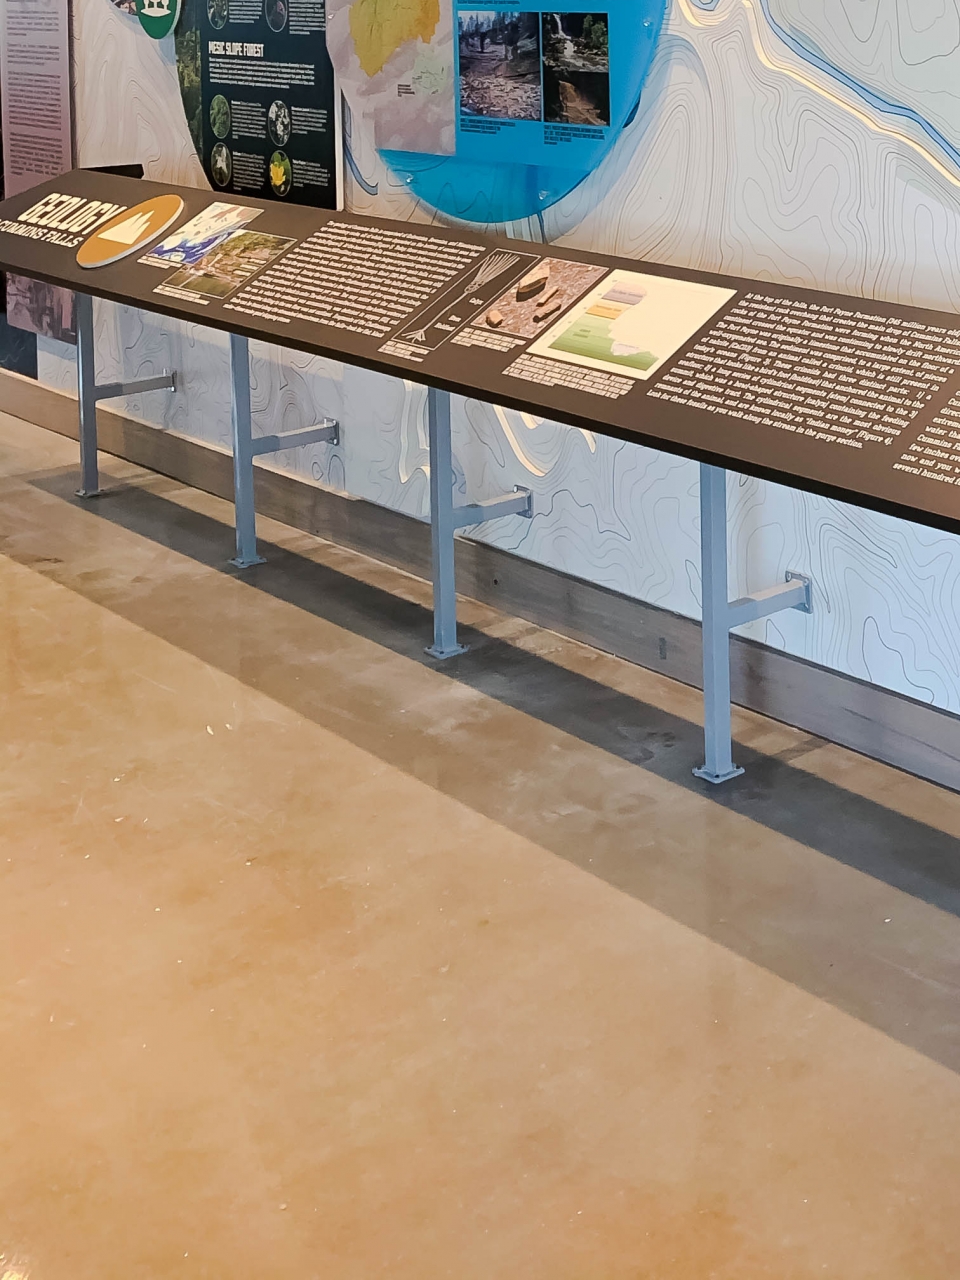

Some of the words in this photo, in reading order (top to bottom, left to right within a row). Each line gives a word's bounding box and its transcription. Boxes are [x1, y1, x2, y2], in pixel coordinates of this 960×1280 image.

[244, 43, 265, 57] FOREST
[17, 192, 128, 235] GEOLOGY
[0, 220, 45, 239] CUMMINS
[41, 230, 84, 248] FALLS
[892, 463, 923, 475] several
[920, 468, 956, 483] hundred
